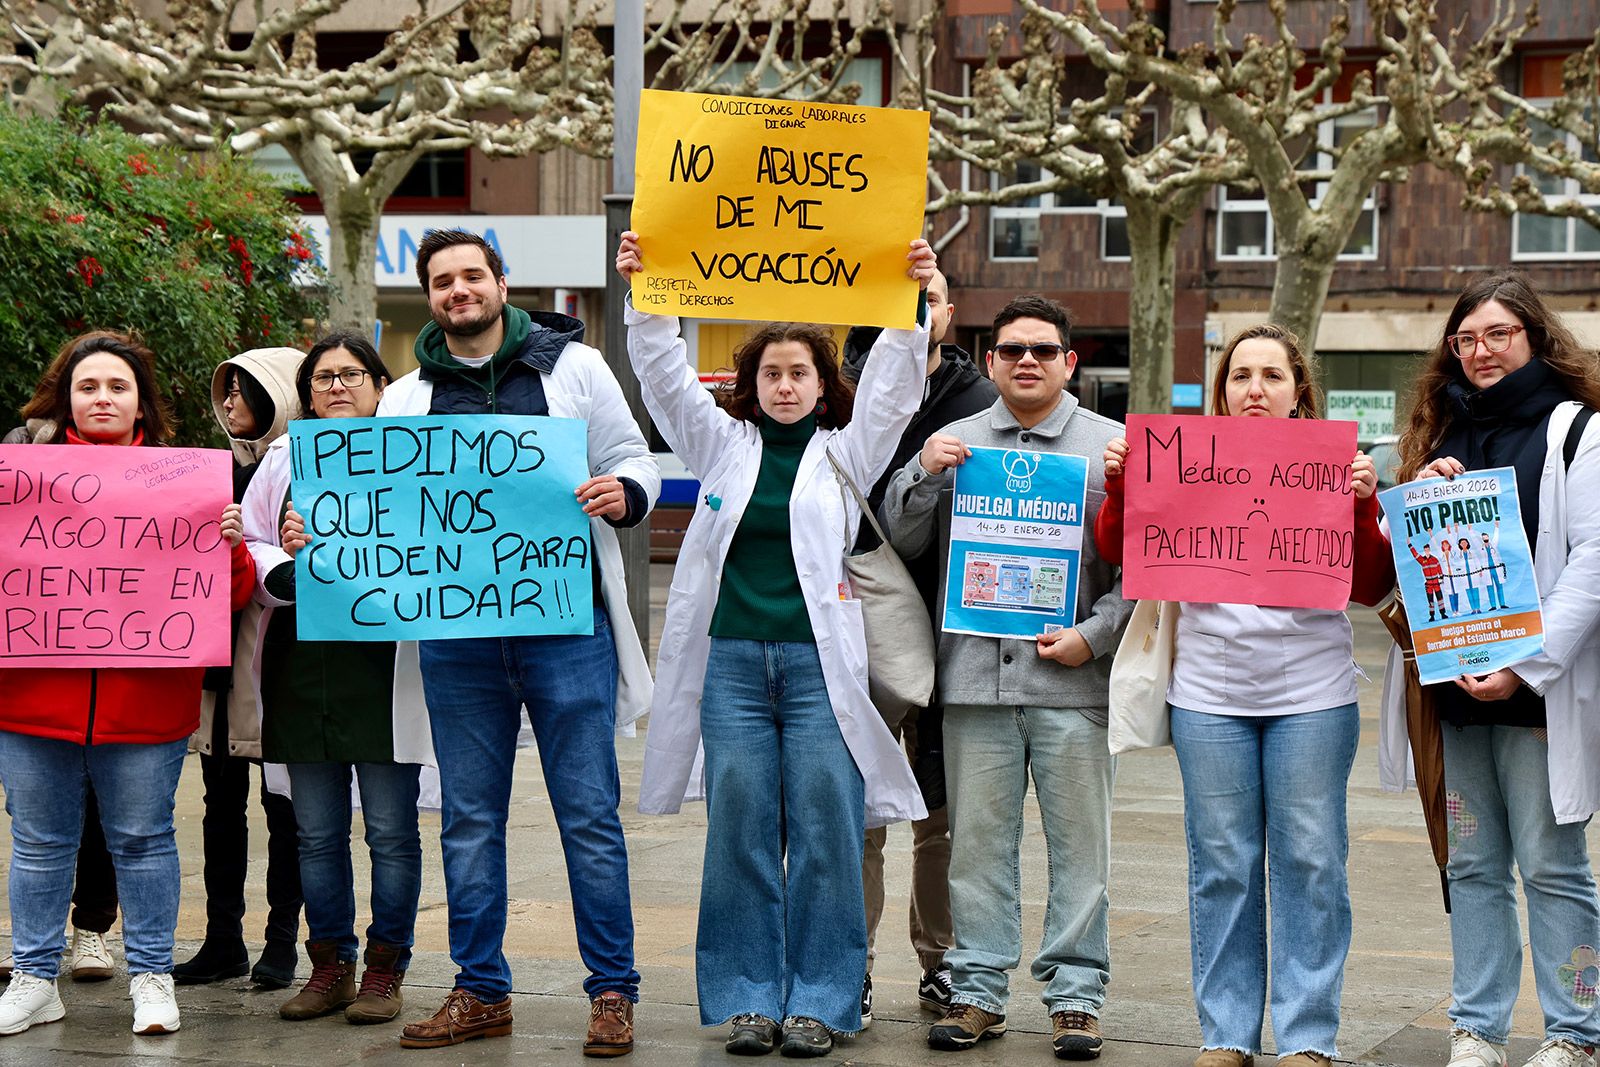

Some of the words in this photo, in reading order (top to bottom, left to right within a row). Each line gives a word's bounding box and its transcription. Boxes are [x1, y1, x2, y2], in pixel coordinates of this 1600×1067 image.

[701, 97, 793, 116] CONDICIONES
[801, 106, 867, 124] LABORALES
[765, 118, 806, 129] DIGNAS
[669, 139, 714, 183] NO
[756, 145, 869, 193] ABUSES
[716, 195, 755, 230] DE
[774, 195, 824, 231] MI
[646, 277, 698, 291] RESPETA
[691, 247, 861, 288] VOCACIÓN
[642, 293, 667, 305] MIS
[679, 293, 734, 306] DERECHOS
[1330, 396, 1393, 409] DISPONIBLE
[1145, 425, 1252, 485] Médico
[1406, 489, 1430, 503] 14-15
[1434, 483, 1464, 498] ENERO
[1467, 478, 1497, 493] 2026
[311, 487, 395, 539] QUE
[419, 486, 497, 537] NOS
[956, 493, 1013, 517] HUELGA
[1017, 496, 1077, 522] MÉDICA
[1404, 506, 1434, 538] ¡YO
[1437, 496, 1501, 529] PARO!
[20, 514, 223, 553] AGOTADO
[976, 522, 1006, 534] 14-15
[1013, 525, 1045, 536] ENERO
[1047, 525, 1062, 537] 26
[308, 542, 461, 584] CUIDEN
[492, 532, 588, 575] PARA
[1268, 527, 1354, 569] AFECTADO
[170, 567, 214, 600] EN
[5, 607, 195, 653] RIESGO
[1466, 621, 1492, 633] contra
[1493, 619, 1502, 629] el
[1500, 627, 1526, 639] Marco
